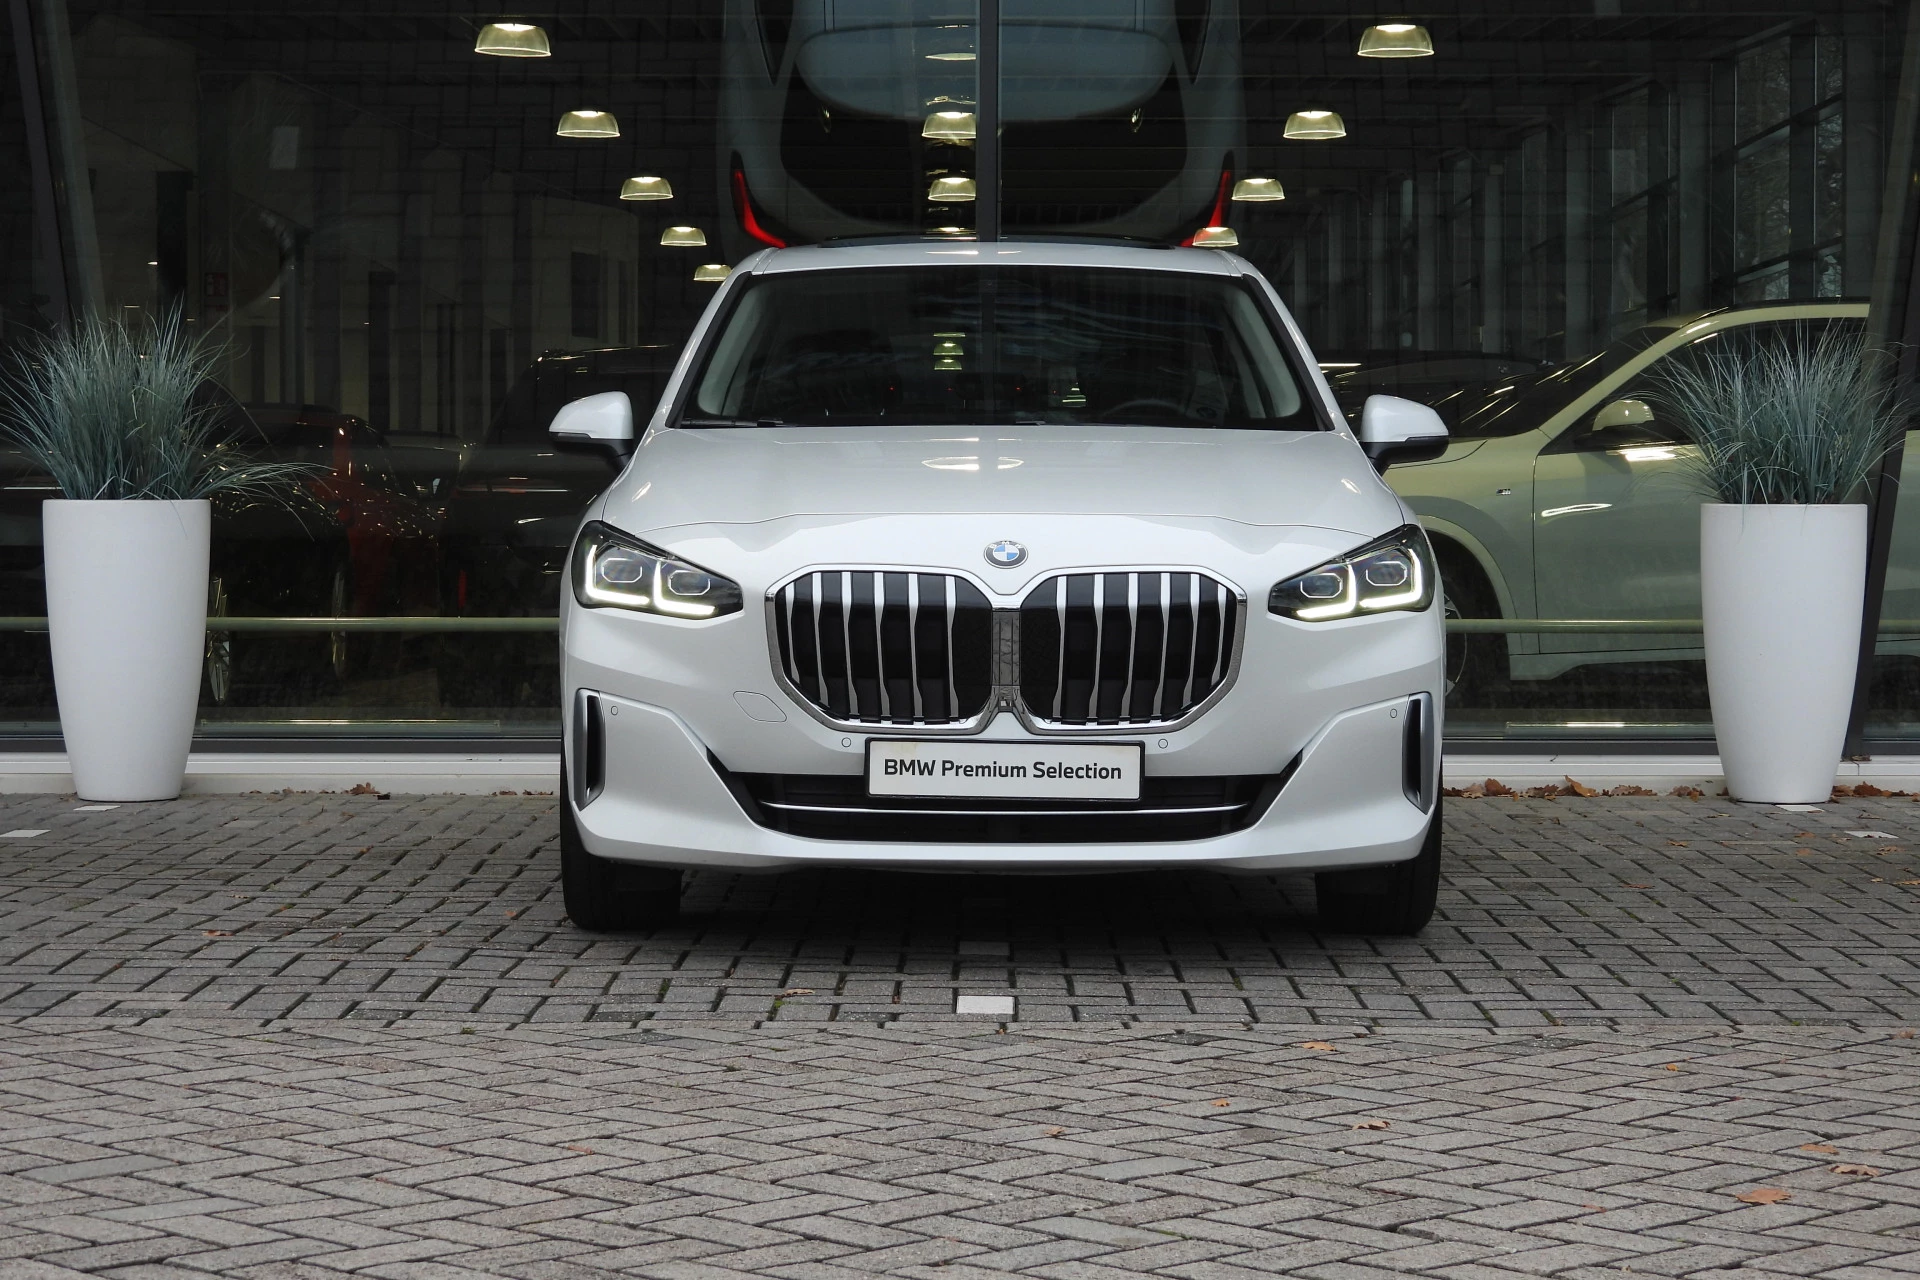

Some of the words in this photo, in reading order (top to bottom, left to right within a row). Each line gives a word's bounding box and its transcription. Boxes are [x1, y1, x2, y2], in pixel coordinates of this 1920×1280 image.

[884, 758, 936, 777] BMW
[941, 759, 1027, 779] Premium
[1032, 761, 1122, 780] Selection
